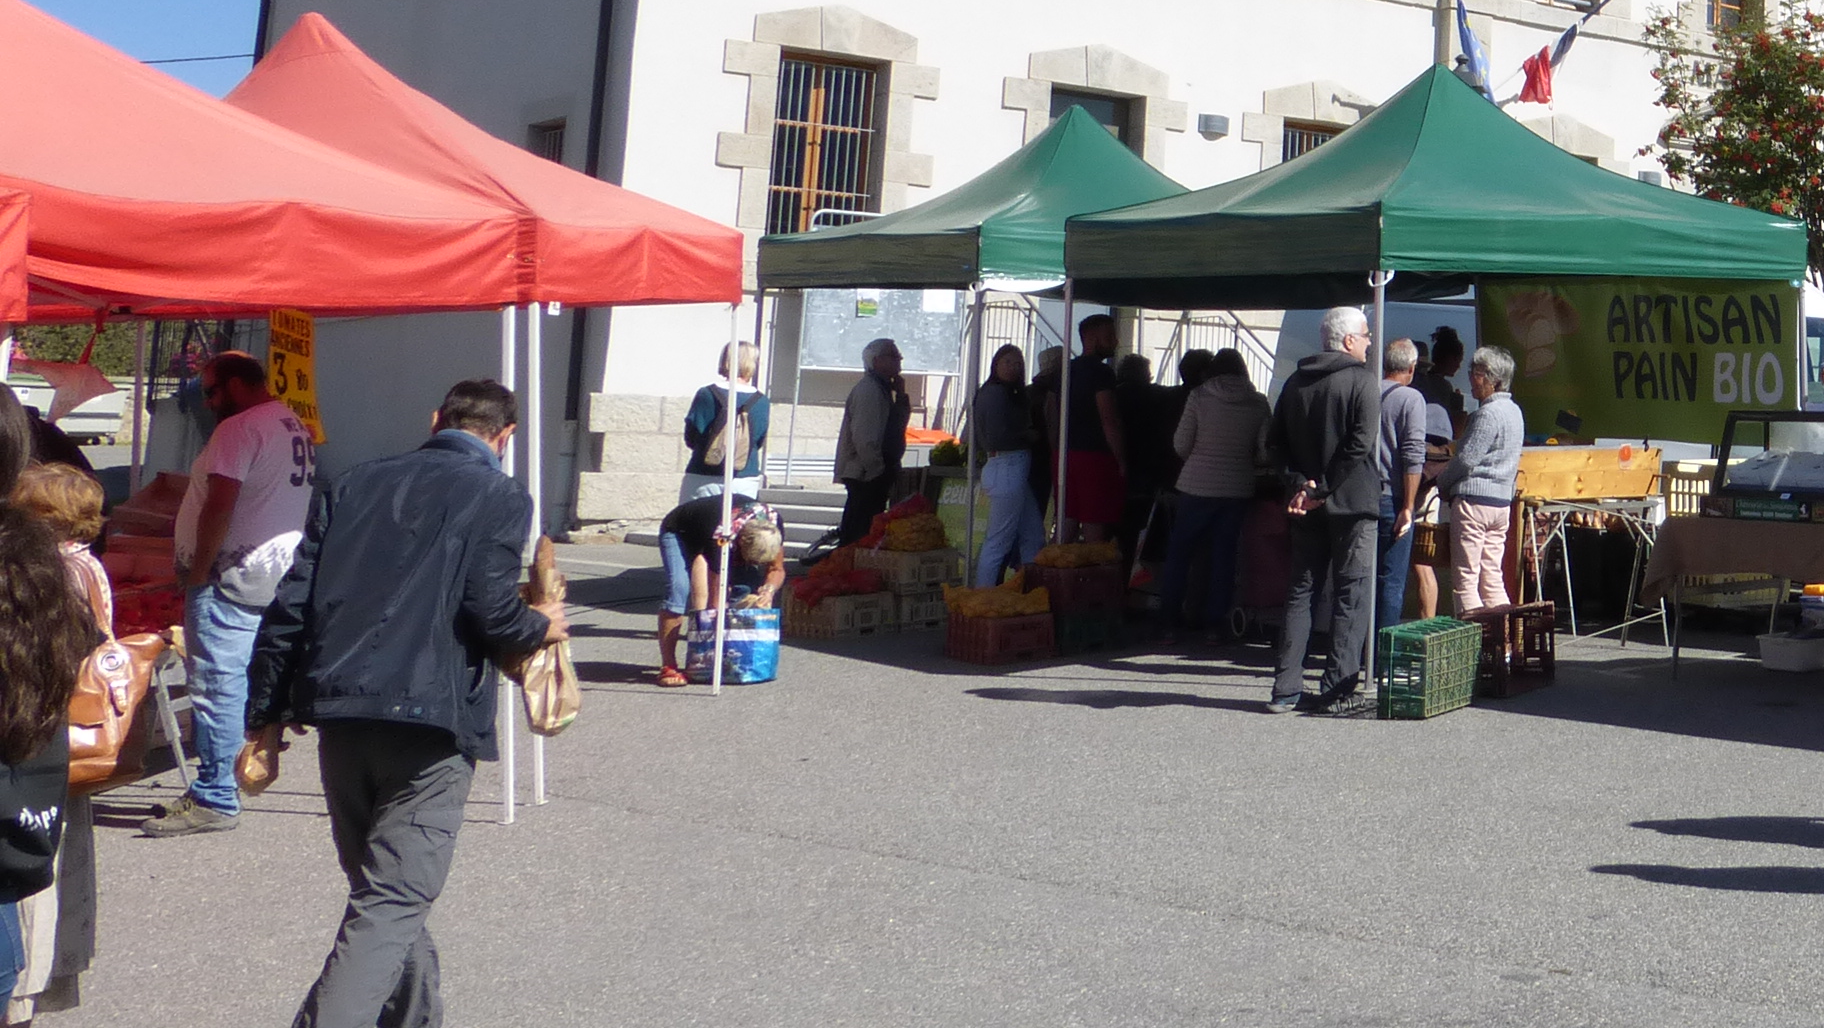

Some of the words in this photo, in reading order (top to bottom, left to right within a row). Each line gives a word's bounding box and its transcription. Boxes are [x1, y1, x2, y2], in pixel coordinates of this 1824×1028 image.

[1607, 294, 1782, 345] ARTISAN
[273, 352, 288, 396] 3
[1613, 350, 1698, 402] PAIN
[1713, 351, 1784, 405] BIO
